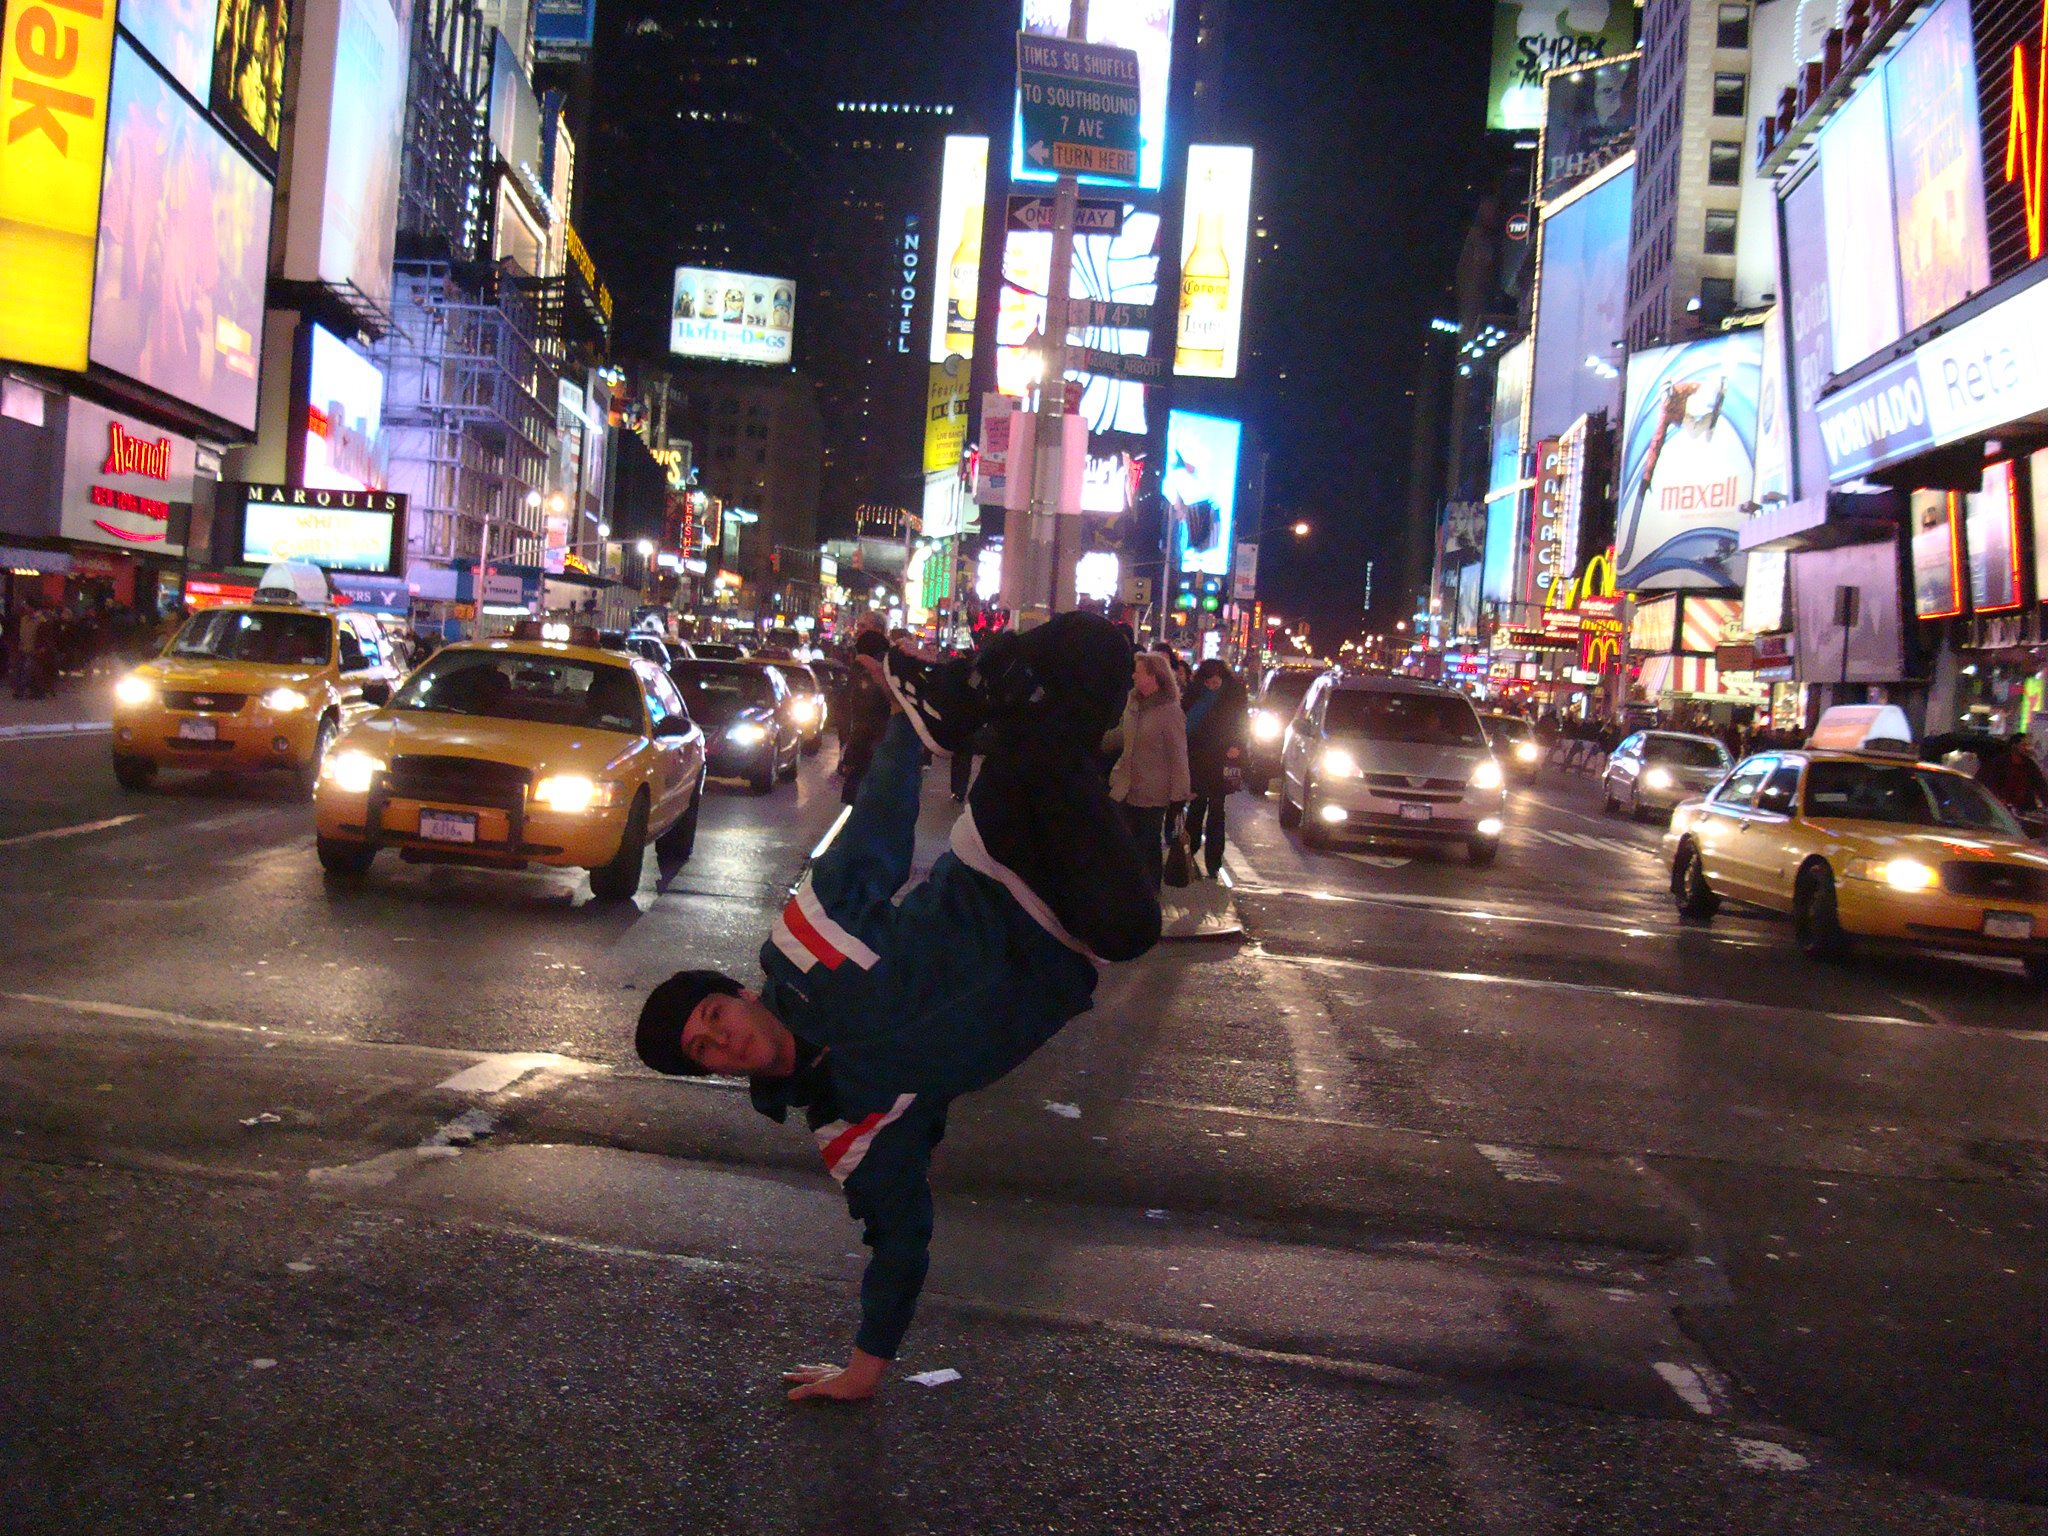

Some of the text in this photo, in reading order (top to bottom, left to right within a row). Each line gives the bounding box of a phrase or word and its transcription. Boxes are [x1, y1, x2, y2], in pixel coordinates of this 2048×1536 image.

[1024, 45, 1136, 80] TIMES SQ SHUFFLE
[1024, 83, 1138, 117] TO SOUTHBOUND
[1060, 115, 1105, 139] 7 AVE
[1056, 143, 1136, 174] TURN HERE
[1076, 209, 1107, 224] WAY
[1509, 222, 1528, 233] TNT
[898, 234, 920, 354] NOVOTEL
[1095, 303, 1149, 328] W 45 ST
[1123, 358, 1163, 381] ABBOTT
[1820, 376, 1924, 466] VORNADO
[104, 421, 171, 482] Marriott
[248, 486, 396, 510] MARQUIS
[1660, 475, 1738, 511] maxell
[1536, 453, 1559, 589] PALACE
